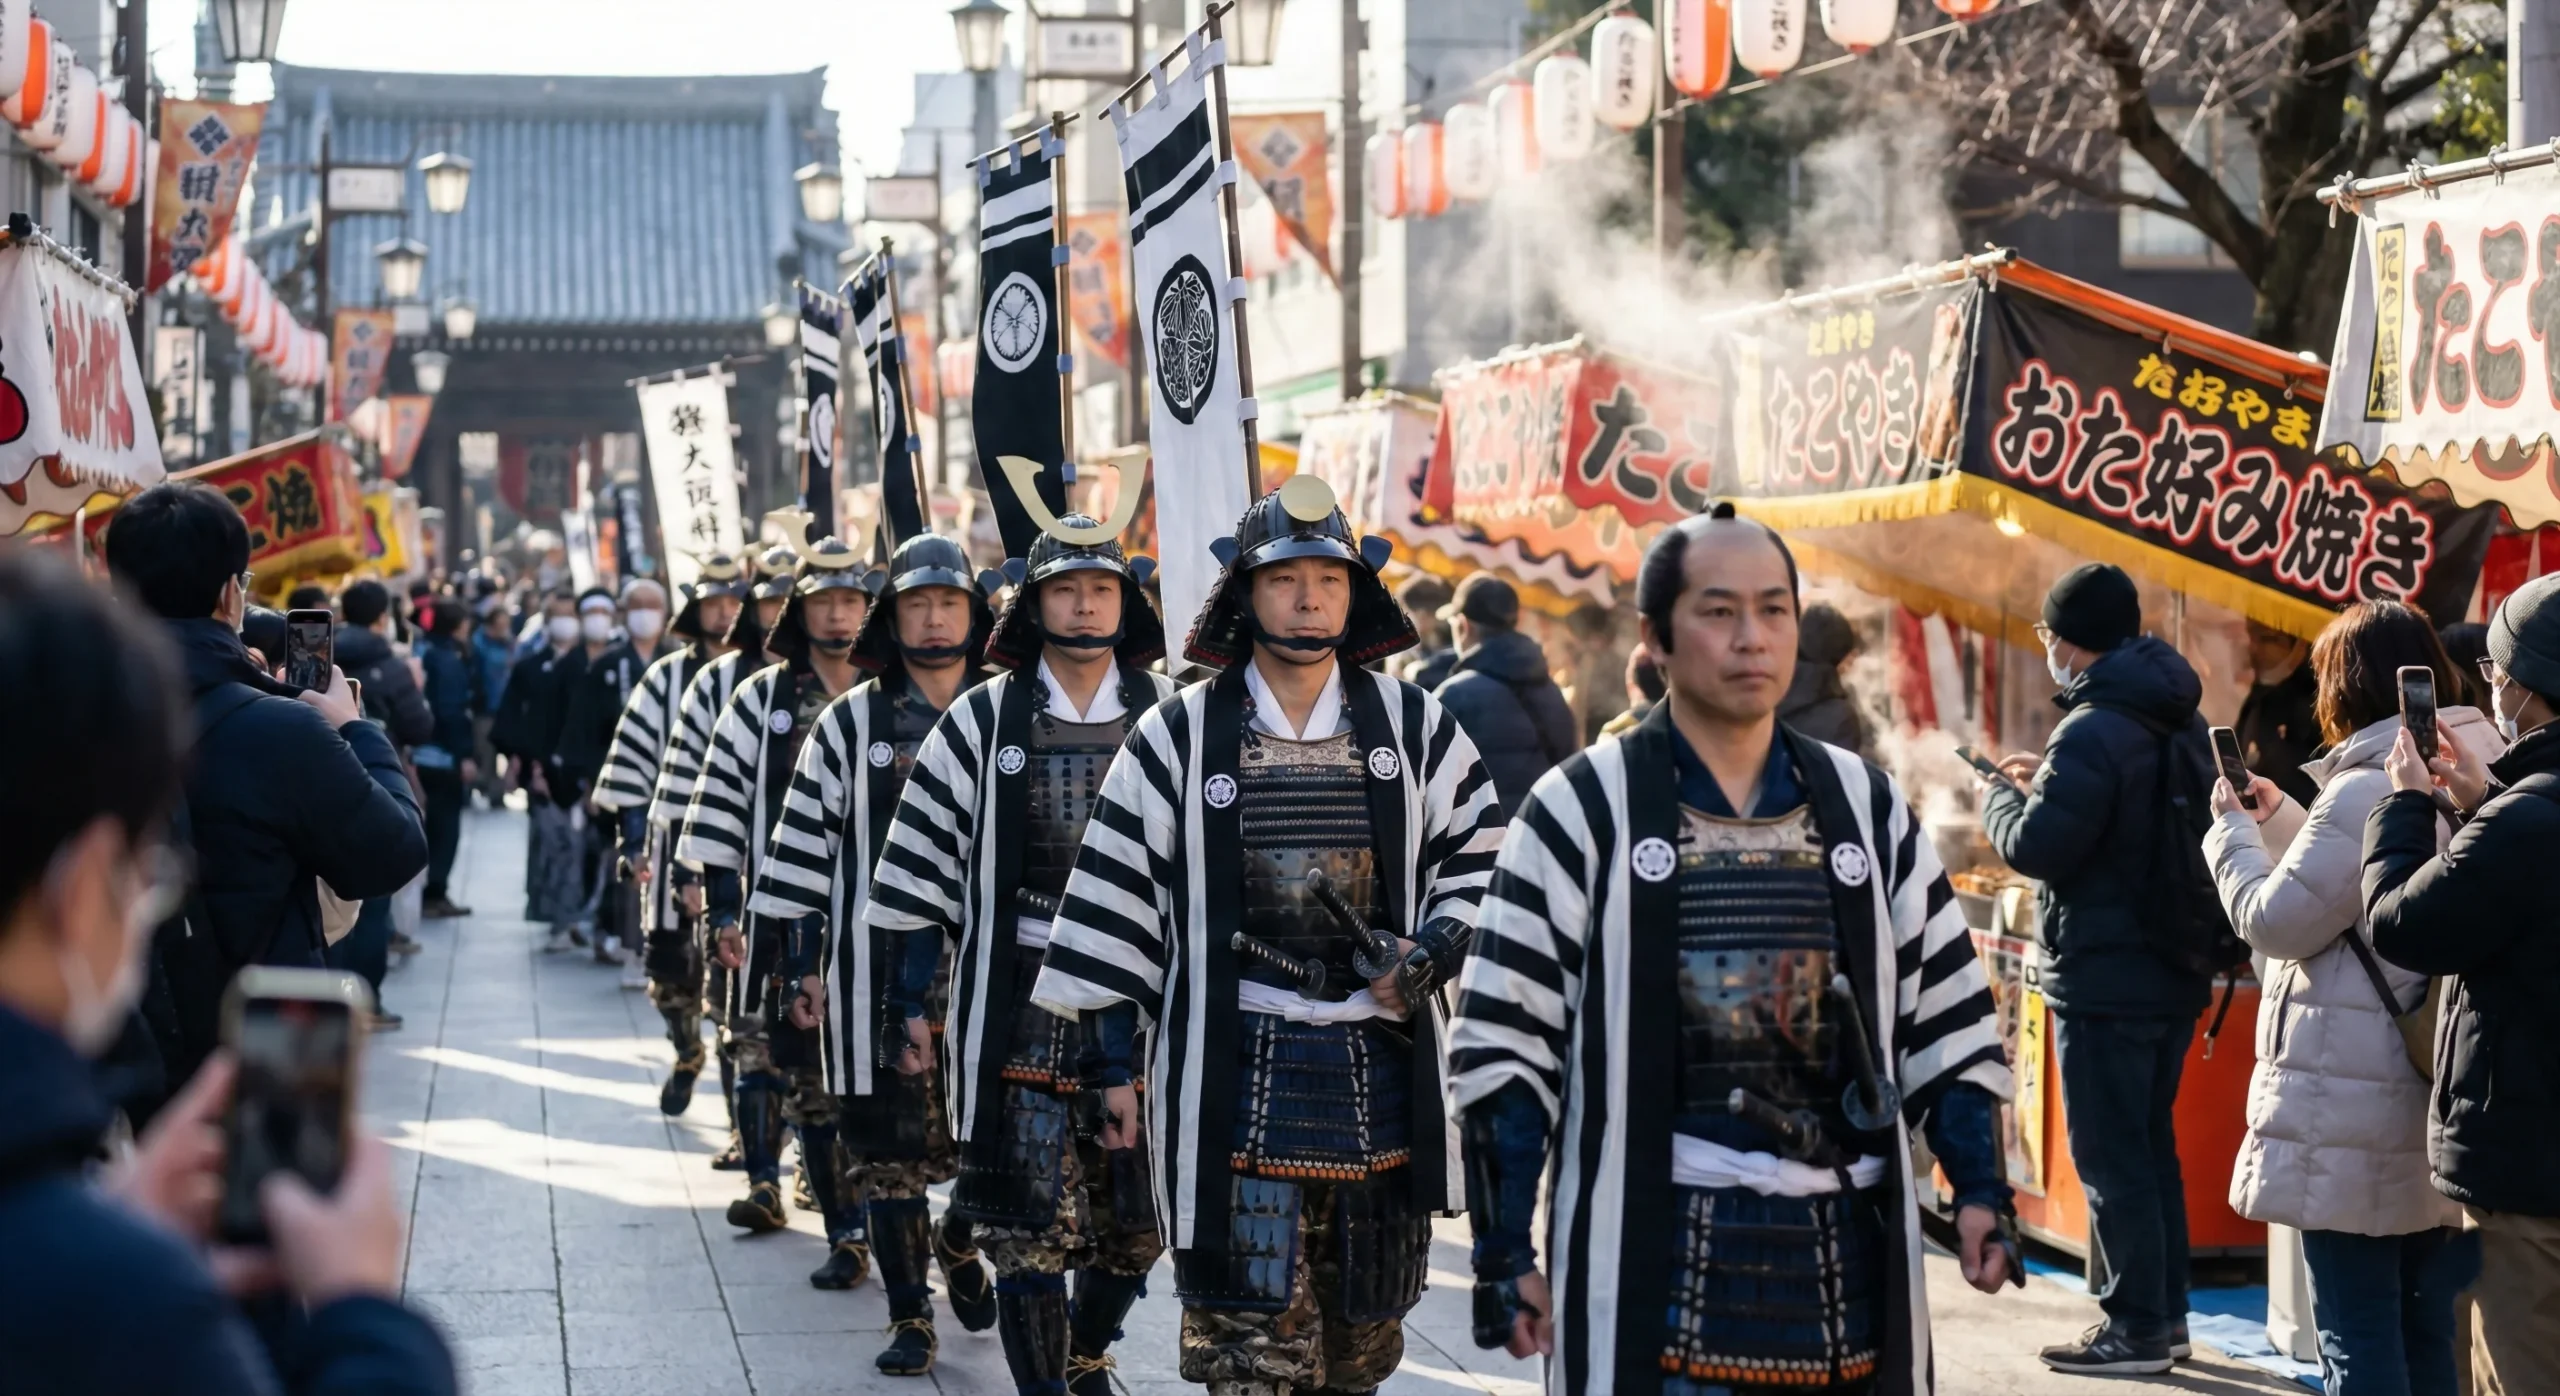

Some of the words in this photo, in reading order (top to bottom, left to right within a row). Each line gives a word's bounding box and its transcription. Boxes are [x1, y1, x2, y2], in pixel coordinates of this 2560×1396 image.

[1768, 346, 1919, 485] たこやき
[1992, 358, 2434, 602] おた好み焼き
